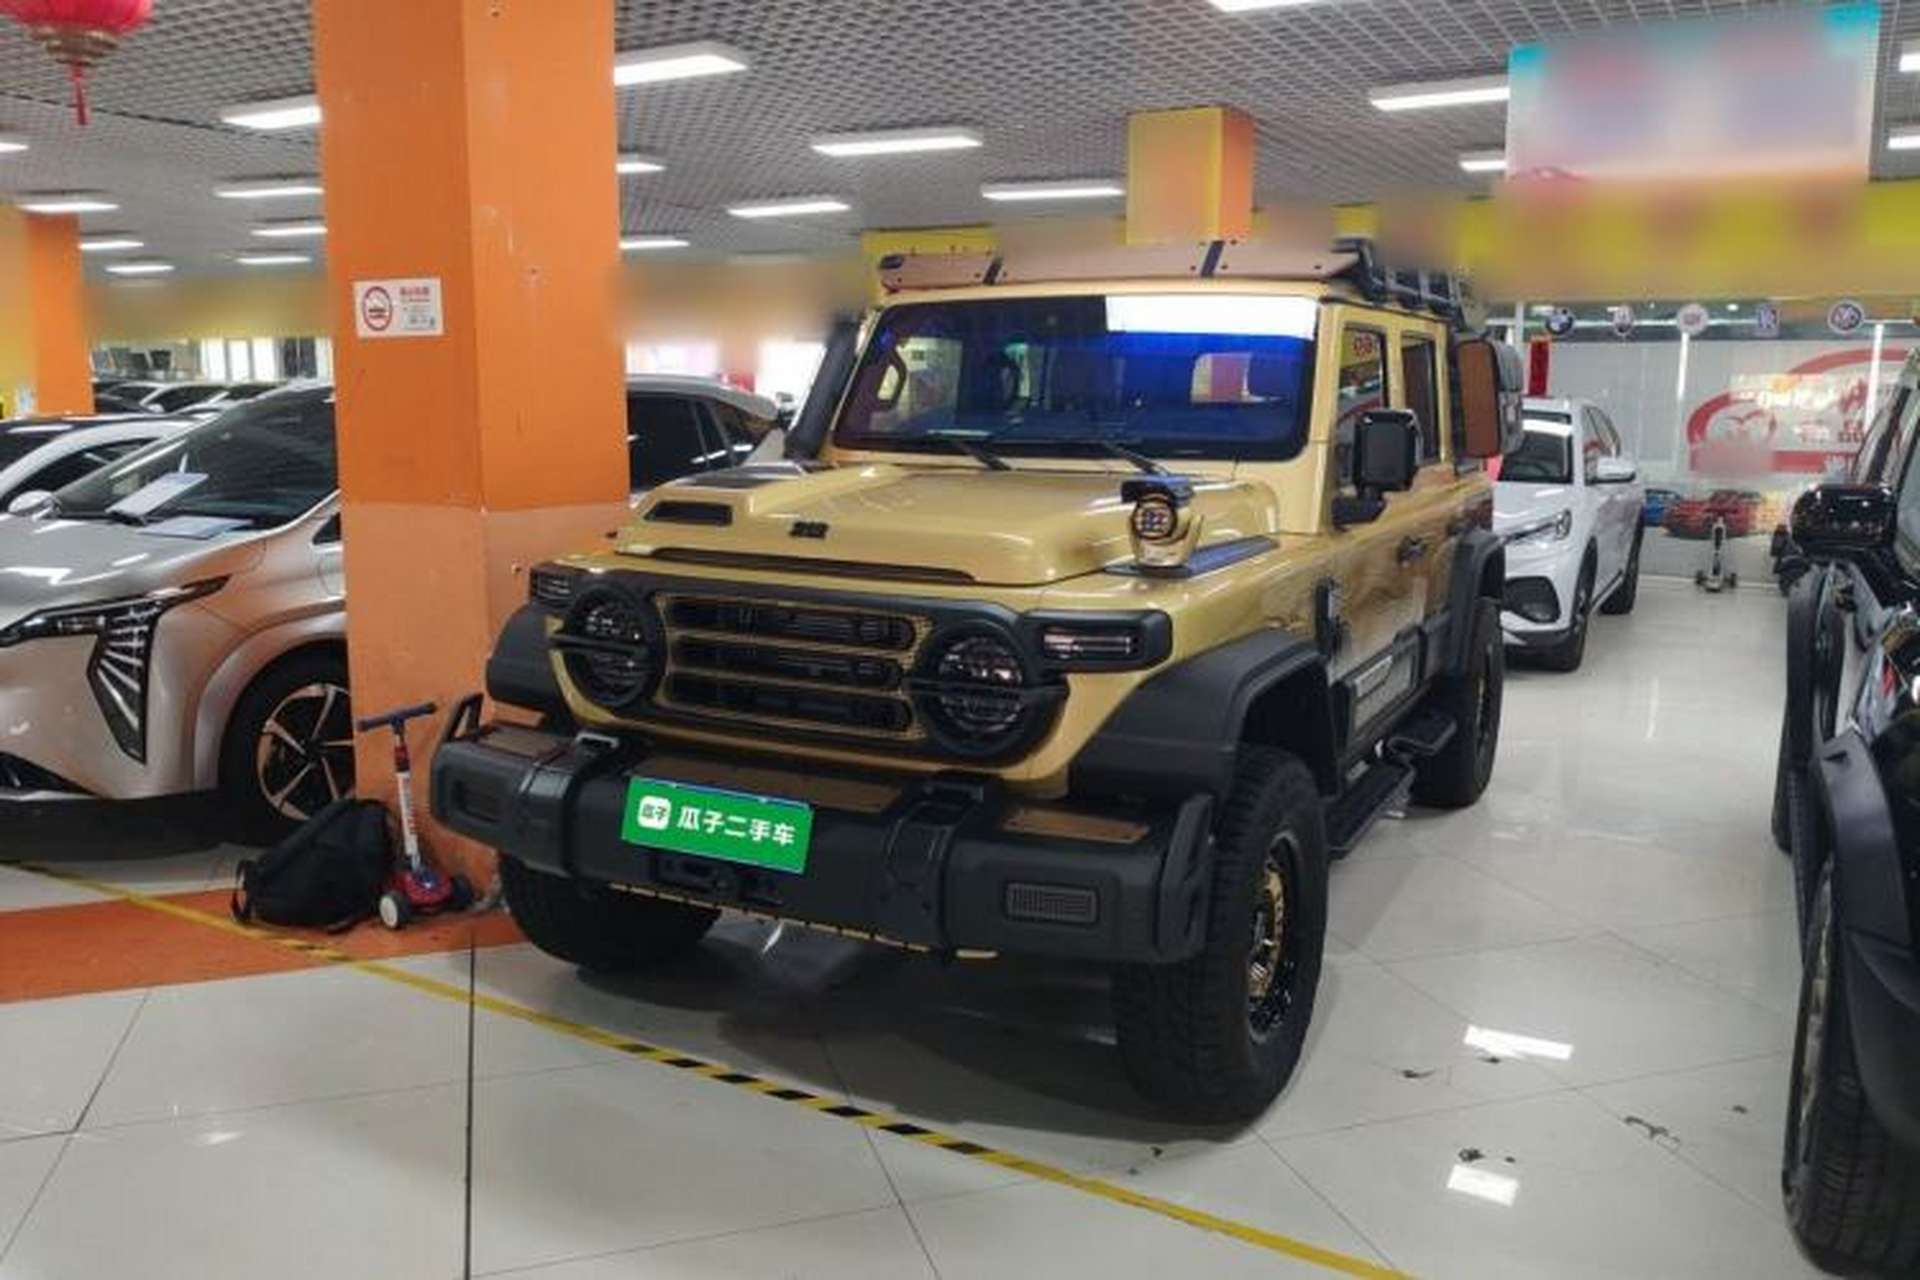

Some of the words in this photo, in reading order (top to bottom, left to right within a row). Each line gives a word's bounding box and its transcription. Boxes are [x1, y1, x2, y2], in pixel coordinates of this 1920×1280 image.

[677, 805, 796, 846] 瓜子二手车
